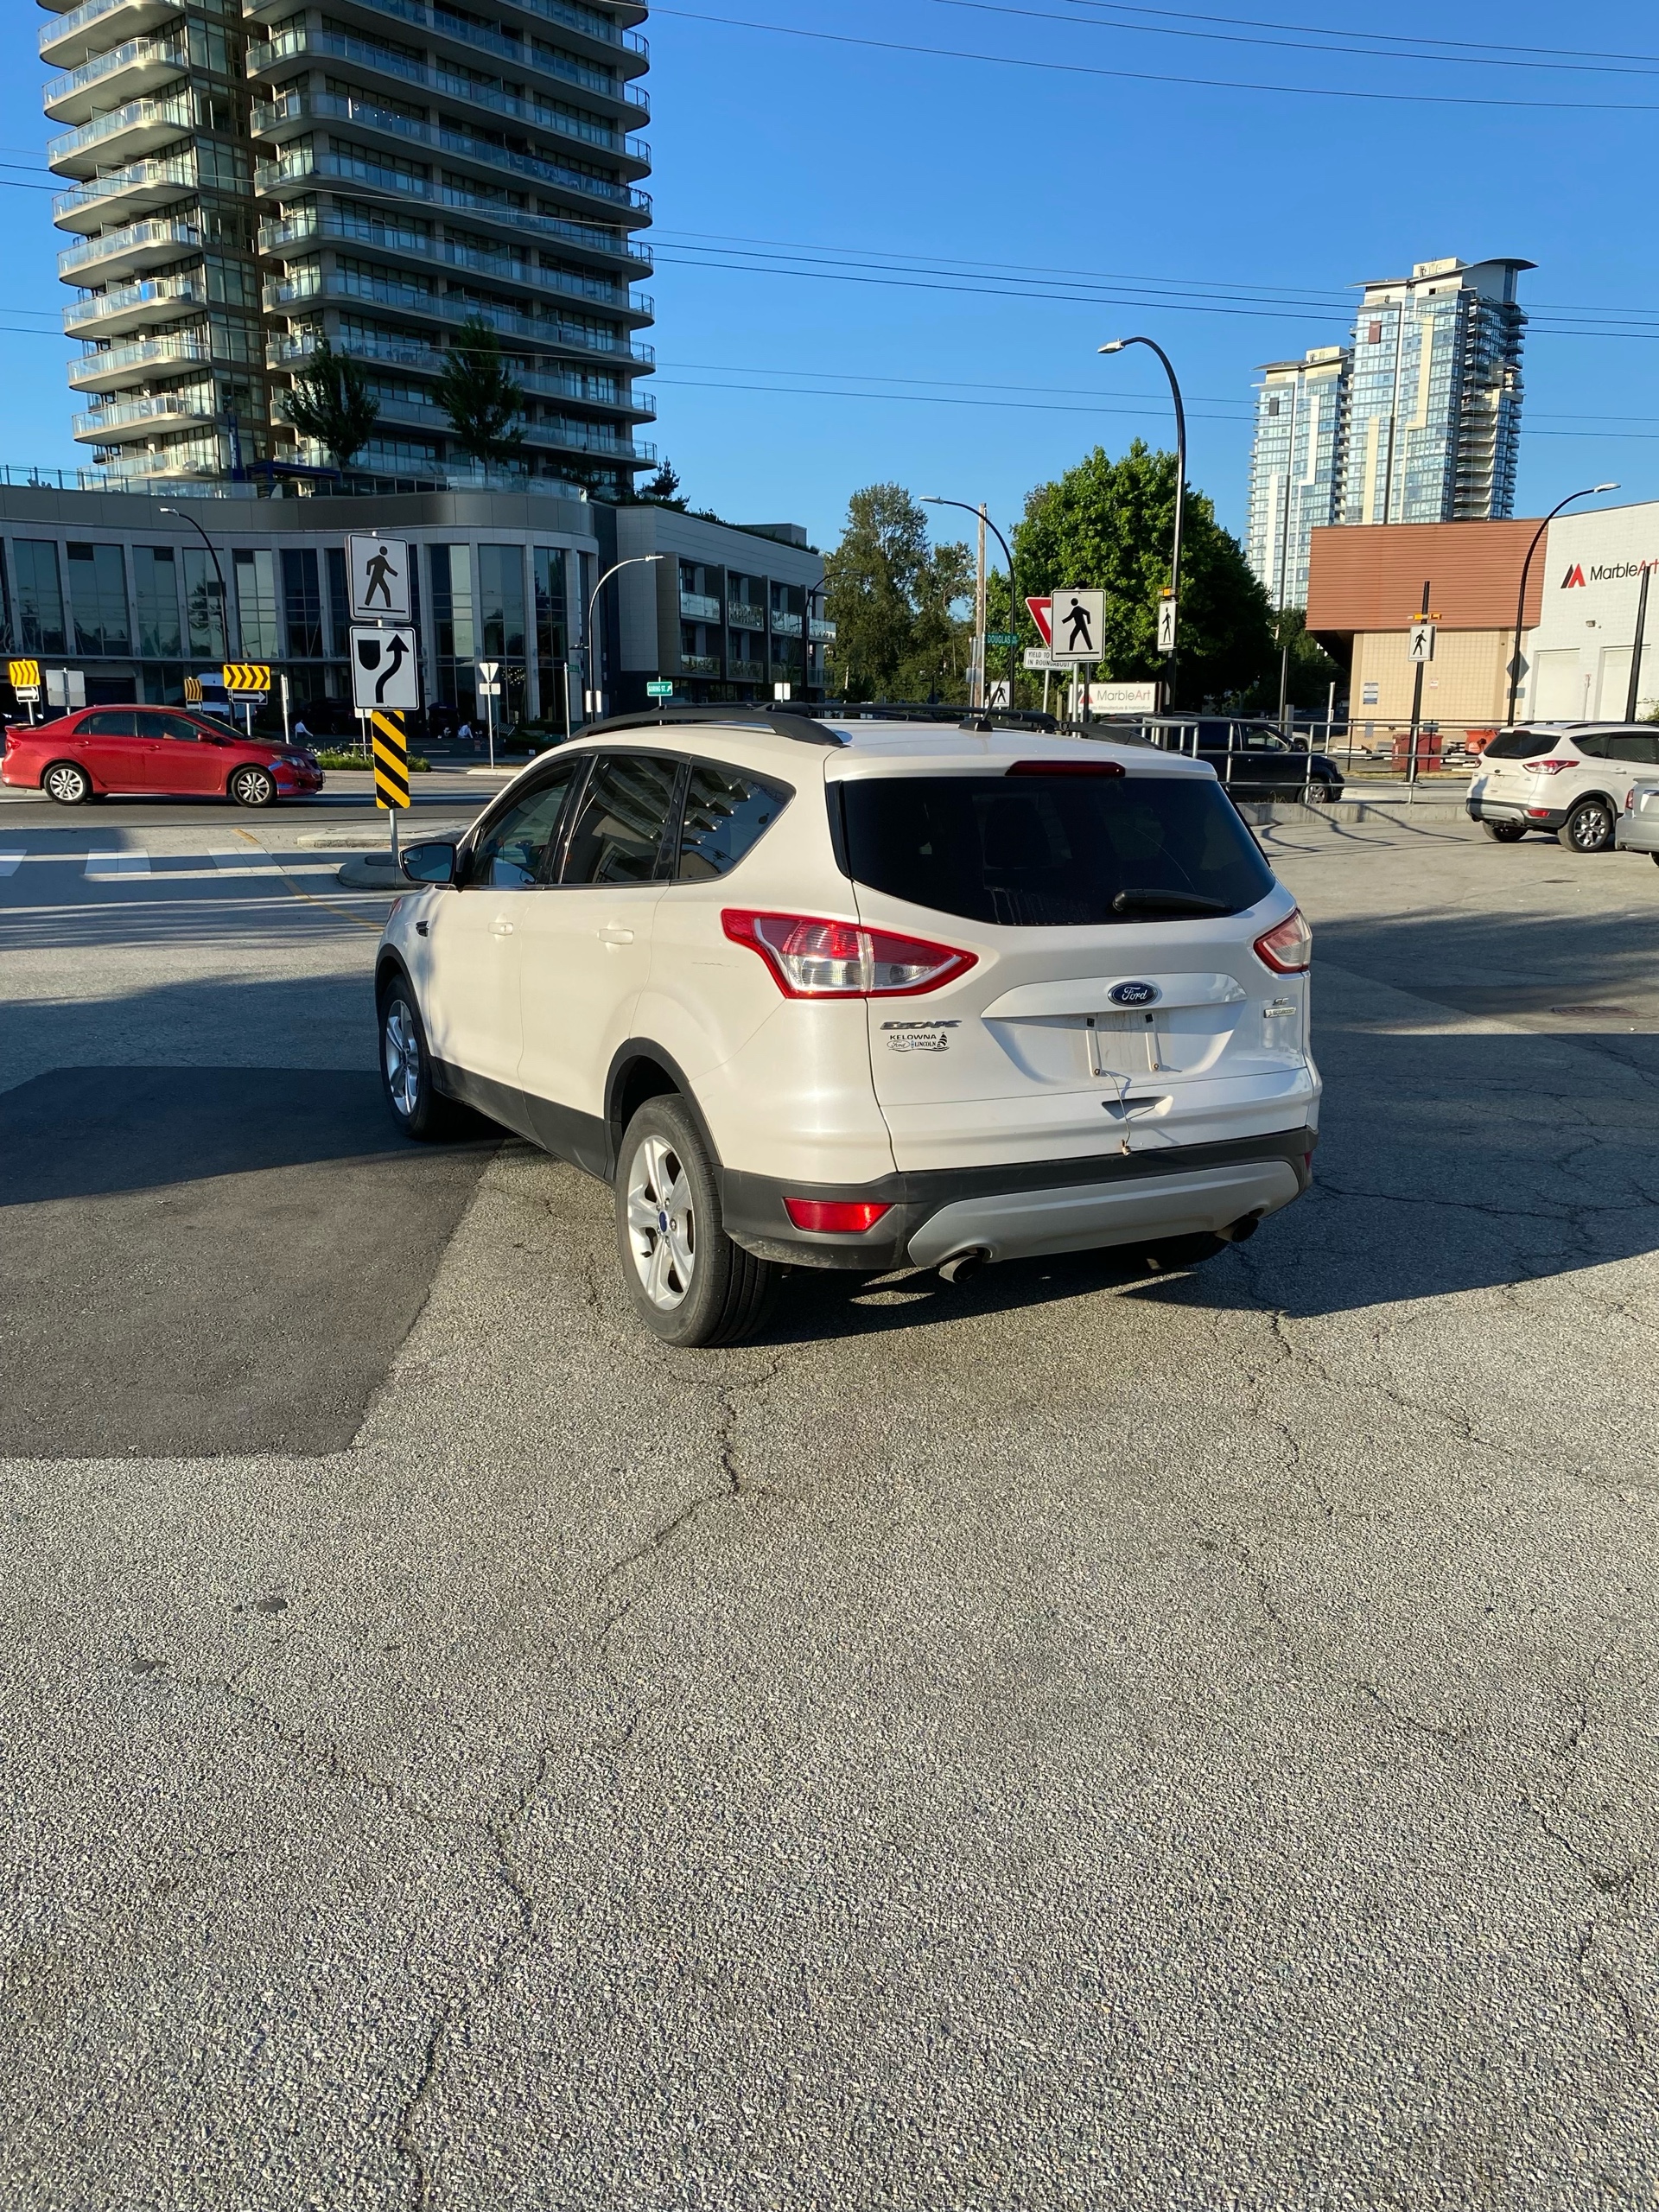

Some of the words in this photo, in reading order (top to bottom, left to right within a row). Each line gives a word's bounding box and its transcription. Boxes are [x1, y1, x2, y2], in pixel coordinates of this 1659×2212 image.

[1590, 558, 1659, 581] MarbleArt
[987, 634, 1011, 645] DOUGLAS
[1096, 690, 1151, 701] MarbleArt
[1122, 986, 1147, 1001] Ford
